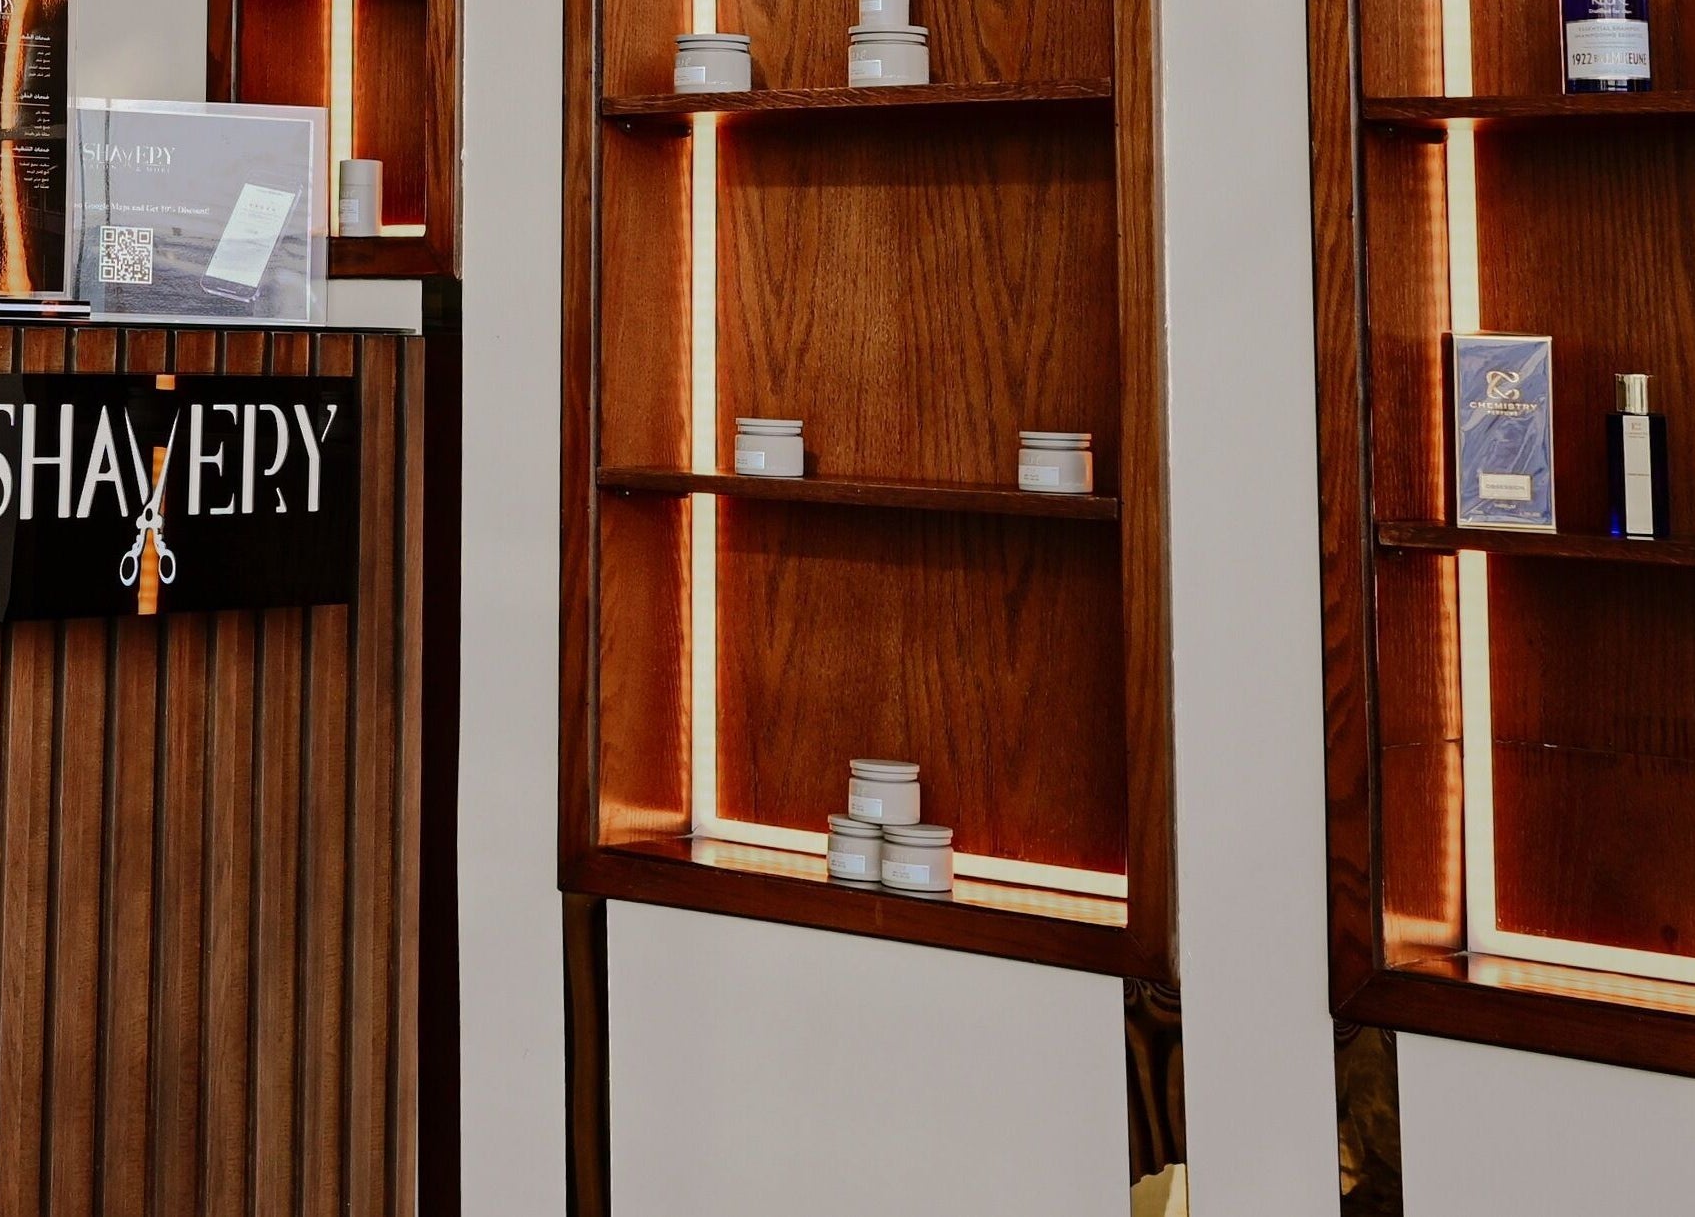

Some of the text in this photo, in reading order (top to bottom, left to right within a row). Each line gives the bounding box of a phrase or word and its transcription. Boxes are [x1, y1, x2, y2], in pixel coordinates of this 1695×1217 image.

[1572, 53, 1593, 65] 1922
[83, 143, 175, 165] SHAVERY
[112, 203, 130, 213] Maps
[1469, 401, 1538, 412] CHEMISTRY
